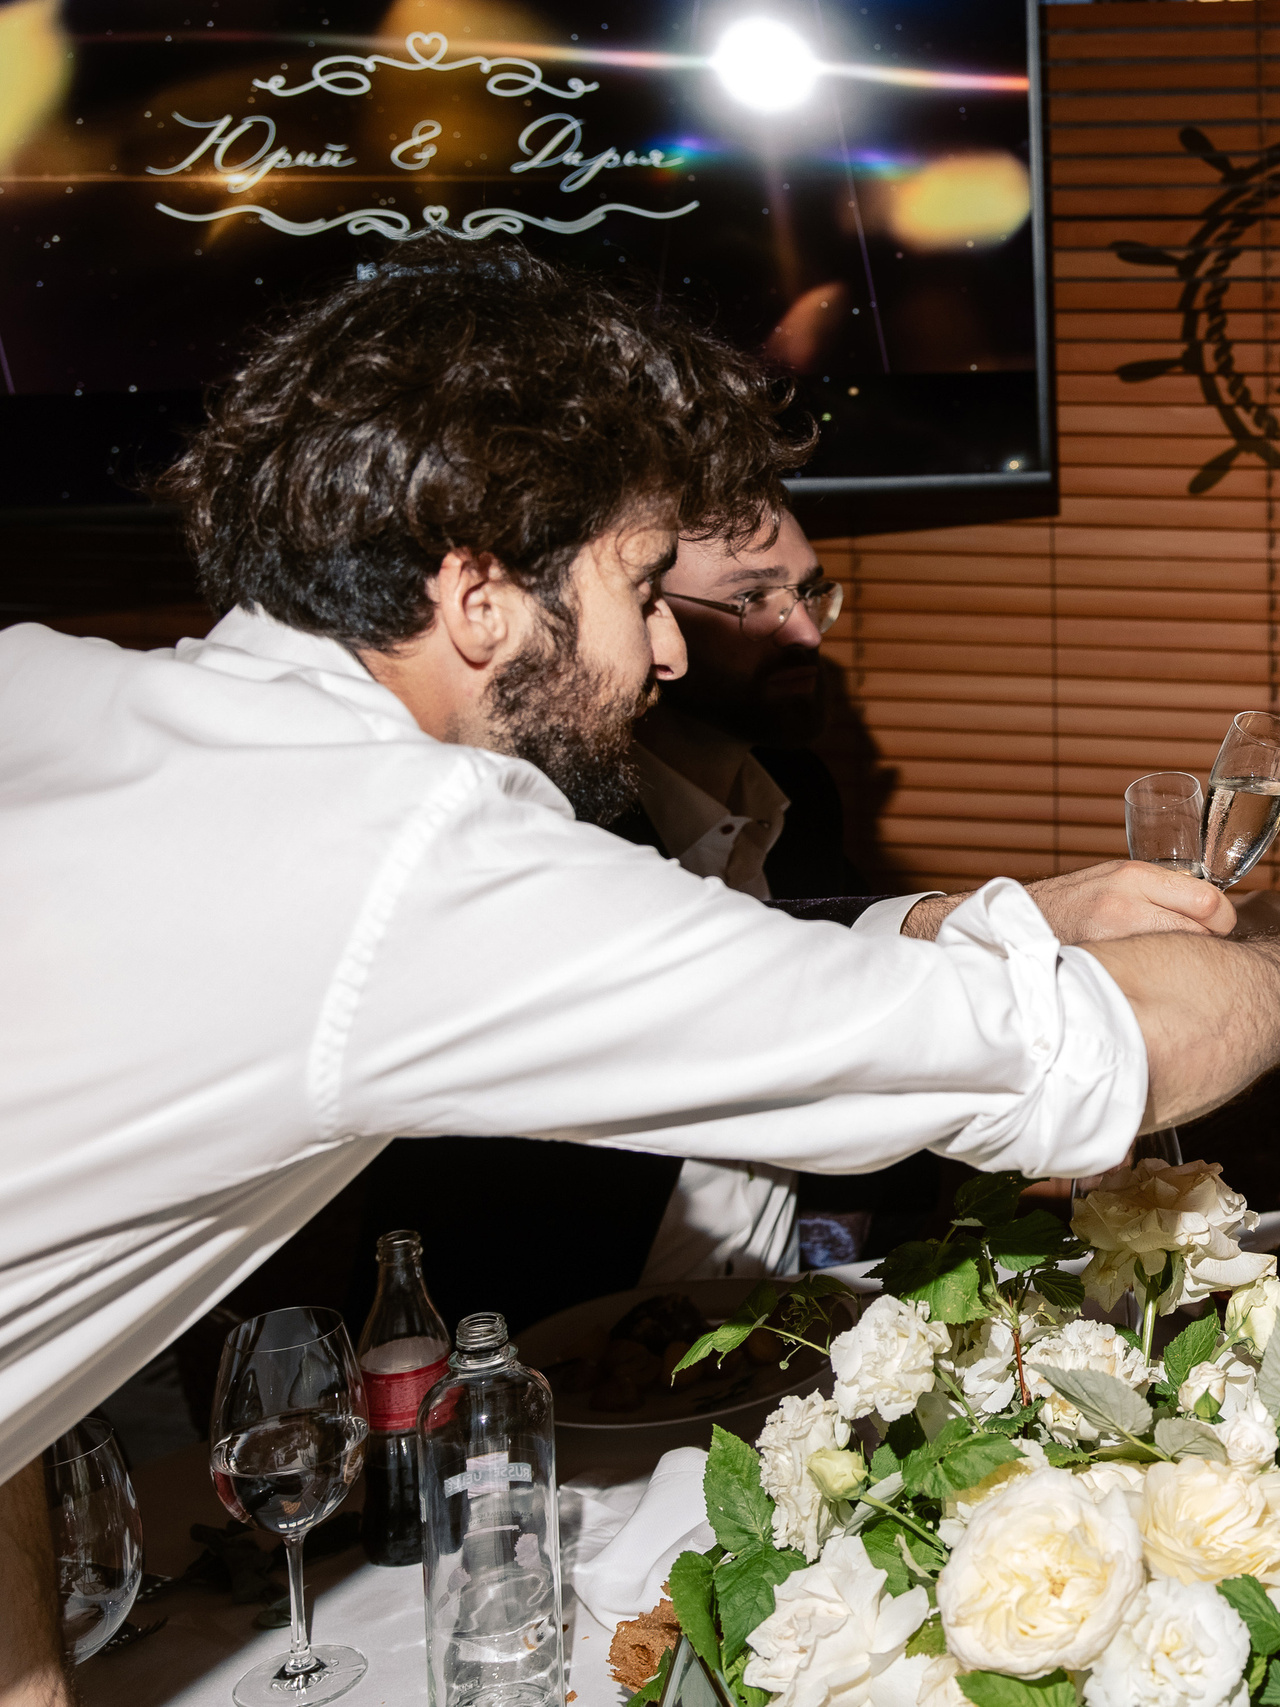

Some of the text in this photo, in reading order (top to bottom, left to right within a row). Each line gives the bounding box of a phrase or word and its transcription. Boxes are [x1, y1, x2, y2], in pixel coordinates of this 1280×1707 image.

[146, 111, 686, 194] Юрий & Дарья
